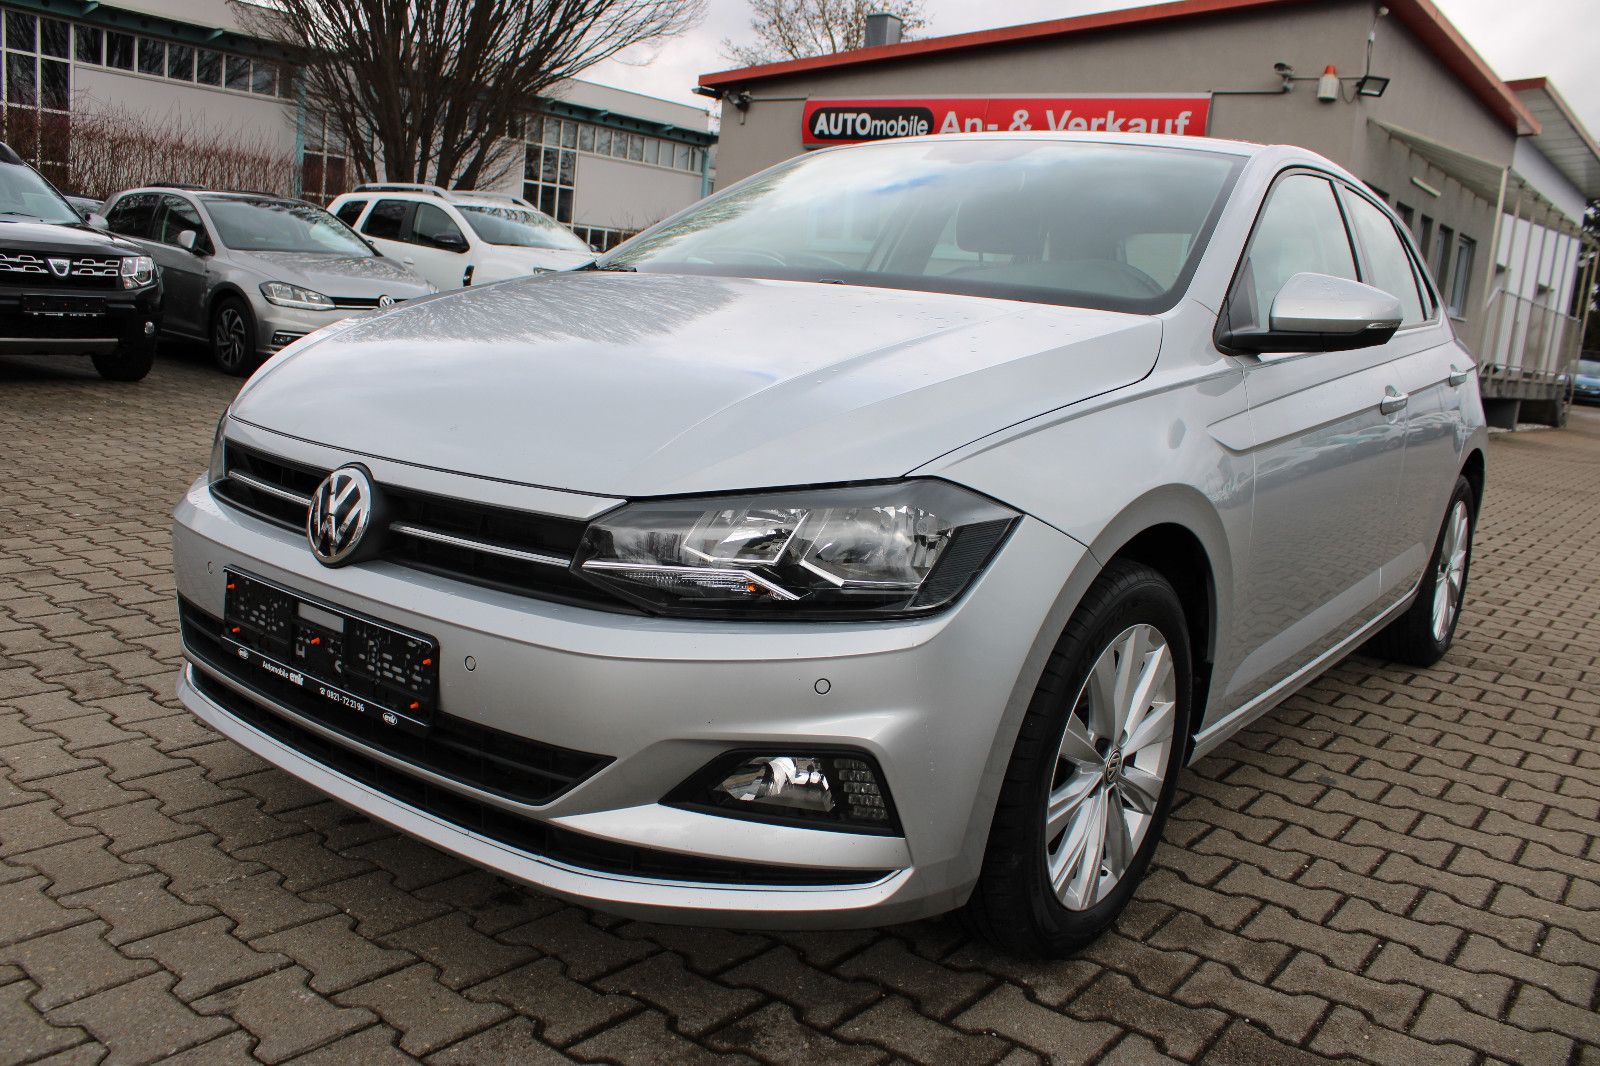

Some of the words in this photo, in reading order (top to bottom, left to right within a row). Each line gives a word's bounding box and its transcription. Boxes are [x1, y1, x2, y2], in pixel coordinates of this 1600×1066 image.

[813, 112, 929, 136] AUTOmobile
[939, 111, 998, 133] An-
[1008, 109, 1032, 131] &
[1046, 110, 1193, 136] Verkauf
[262, 660, 289, 679] Automobile
